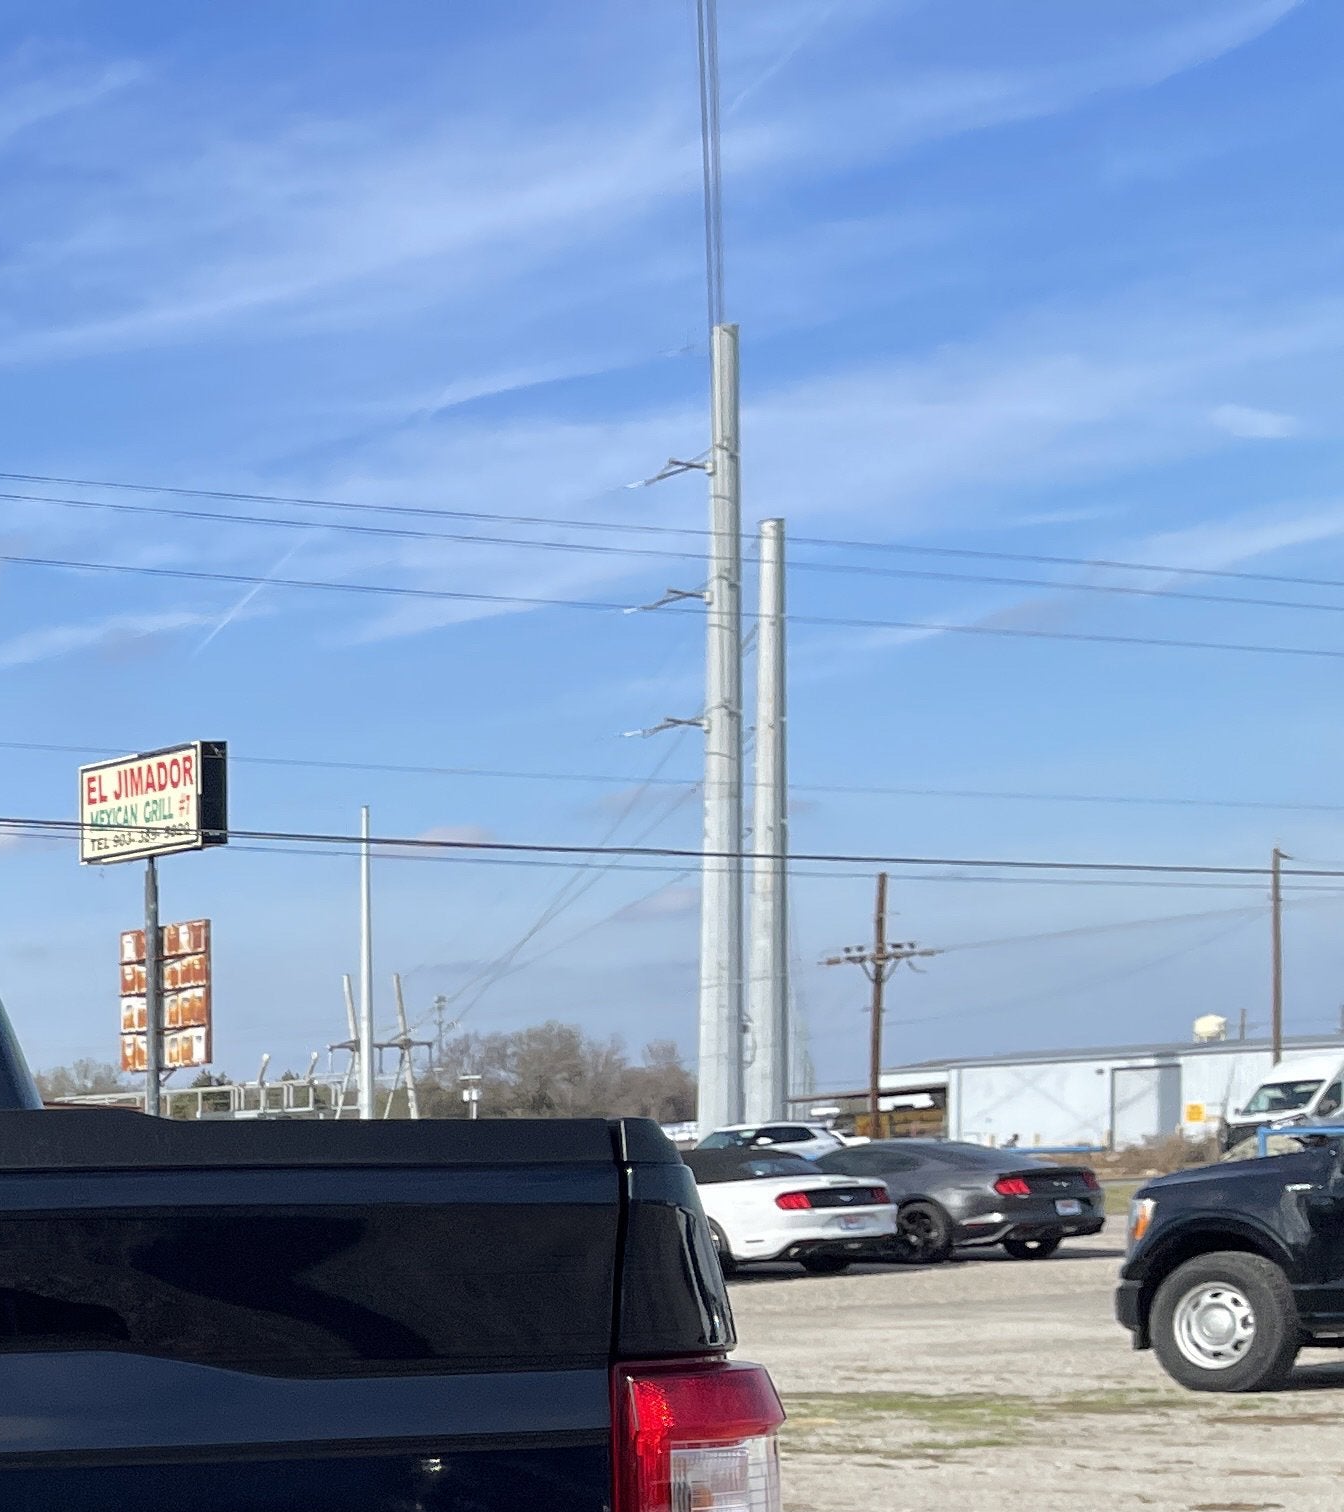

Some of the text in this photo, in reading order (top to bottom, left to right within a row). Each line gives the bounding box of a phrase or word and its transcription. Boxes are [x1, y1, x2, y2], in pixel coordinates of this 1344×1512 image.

[86, 755, 194, 805] EL JIMADOR
[90, 803, 138, 828] MEXICAN
[144, 796, 174, 823] GRILL
[90, 837, 110, 851] TEL
